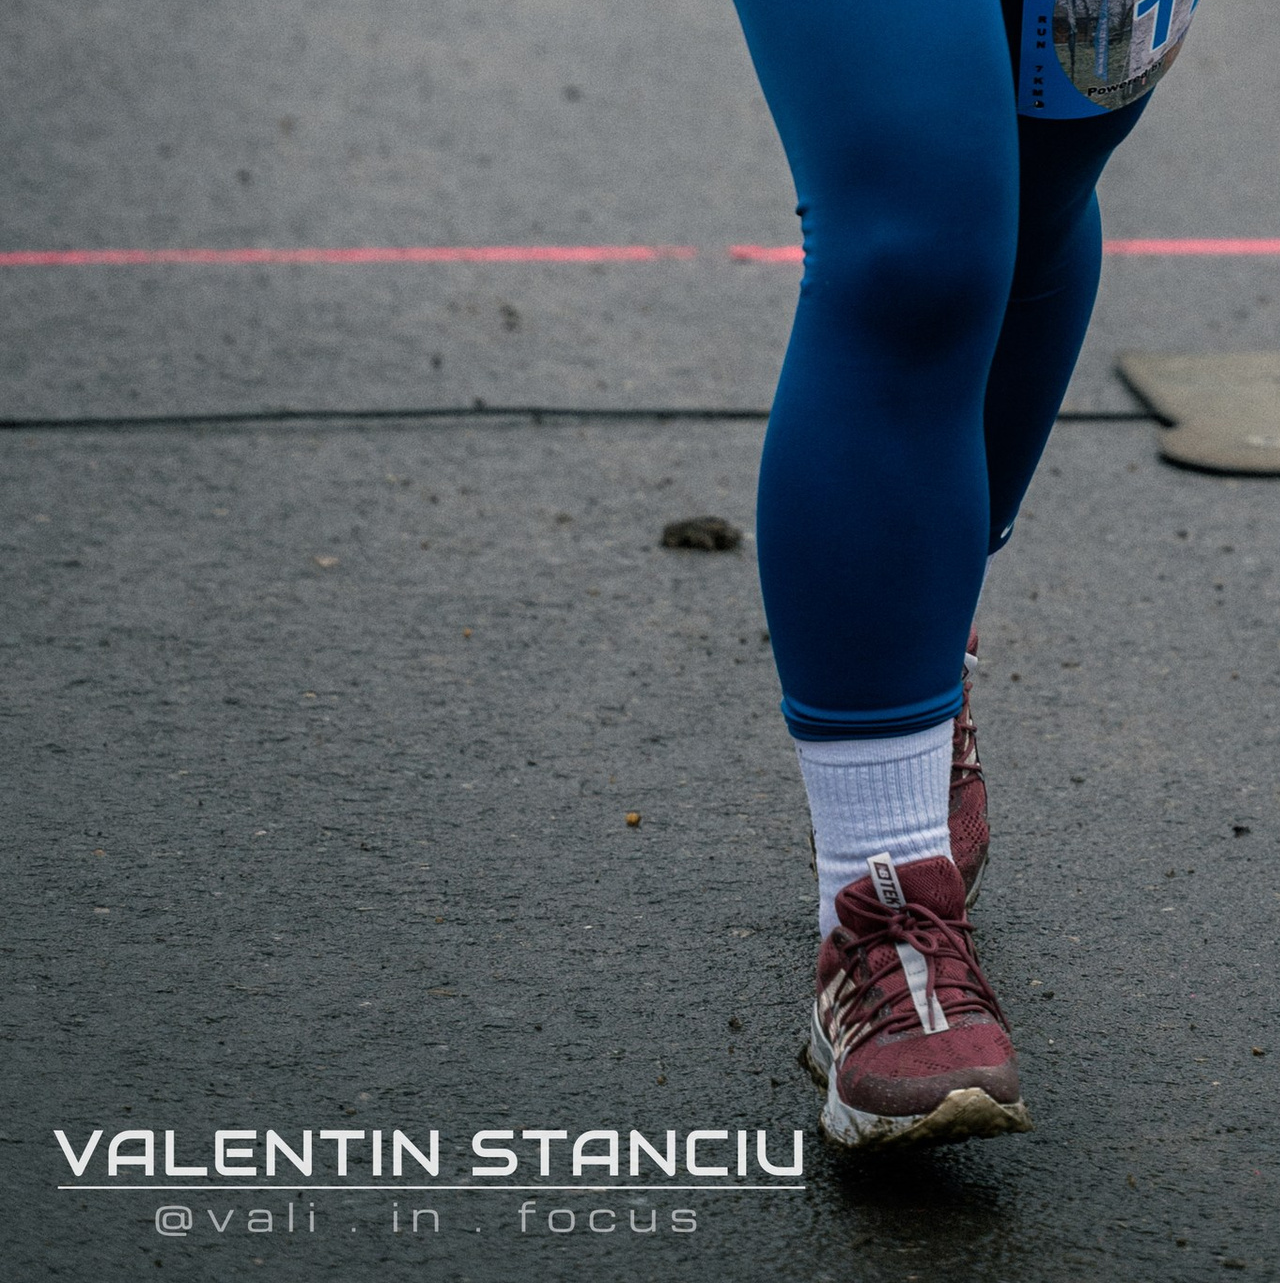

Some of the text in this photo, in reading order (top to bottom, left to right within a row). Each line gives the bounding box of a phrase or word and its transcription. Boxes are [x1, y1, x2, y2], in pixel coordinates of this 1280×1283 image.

[1036, 15, 1048, 49] RUN
[1032, 65, 1044, 97] 7KM
[1087, 69, 1149, 97] Powered
